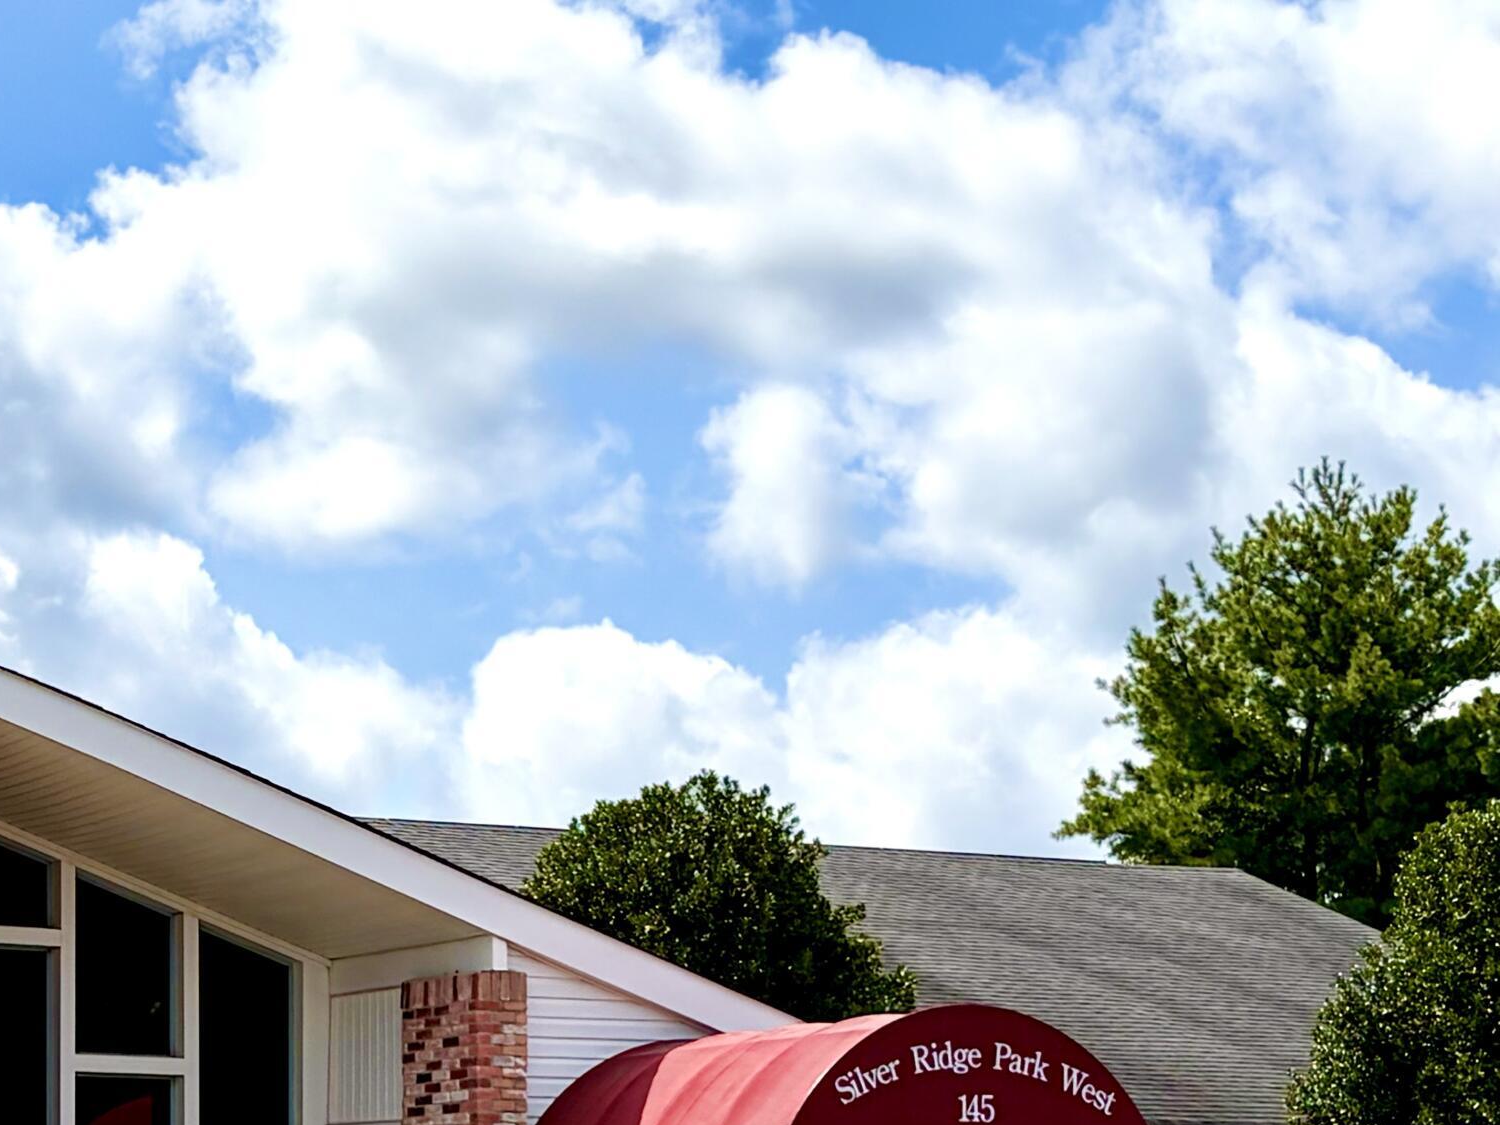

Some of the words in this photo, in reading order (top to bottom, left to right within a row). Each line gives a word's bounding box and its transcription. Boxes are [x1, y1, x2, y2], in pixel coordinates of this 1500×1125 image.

[834, 1059, 900, 1105] Silver
[910, 1040, 982, 1074] Ridge
[993, 1042, 1049, 1082] Park
[1061, 1062, 1116, 1116] West
[958, 1094, 995, 1123] 145
